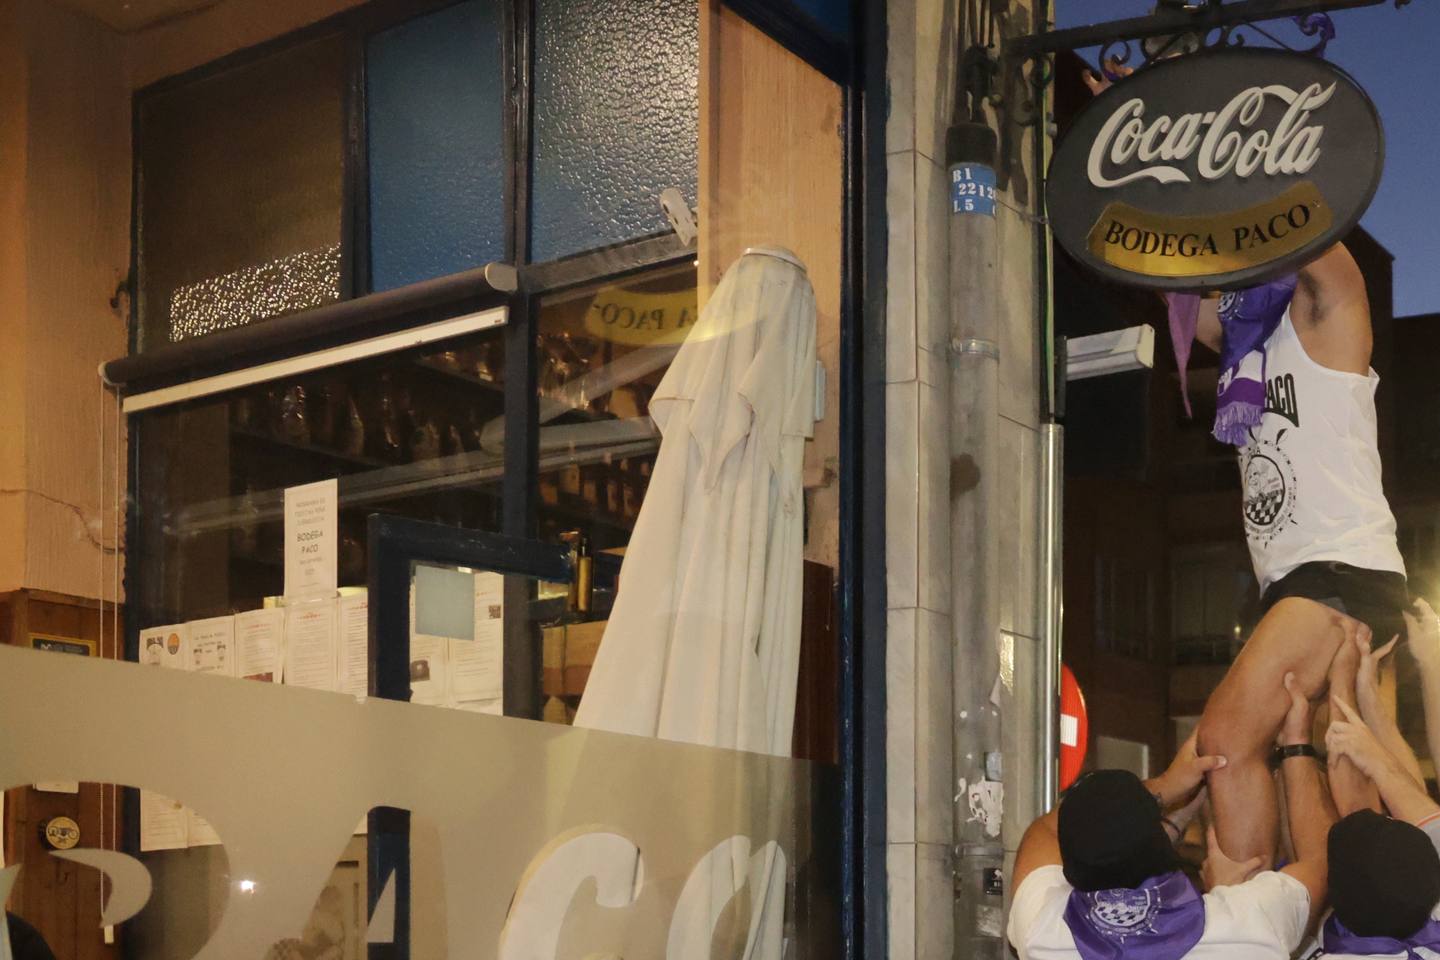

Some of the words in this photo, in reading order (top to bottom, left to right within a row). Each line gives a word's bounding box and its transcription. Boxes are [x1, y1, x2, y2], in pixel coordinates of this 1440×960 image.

[1087, 80, 1337, 188] Coca-Cola
[1104, 219, 1219, 258] BODEGA
[1233, 203, 1311, 252] PACO
[1266, 373, 1299, 424] ACO
